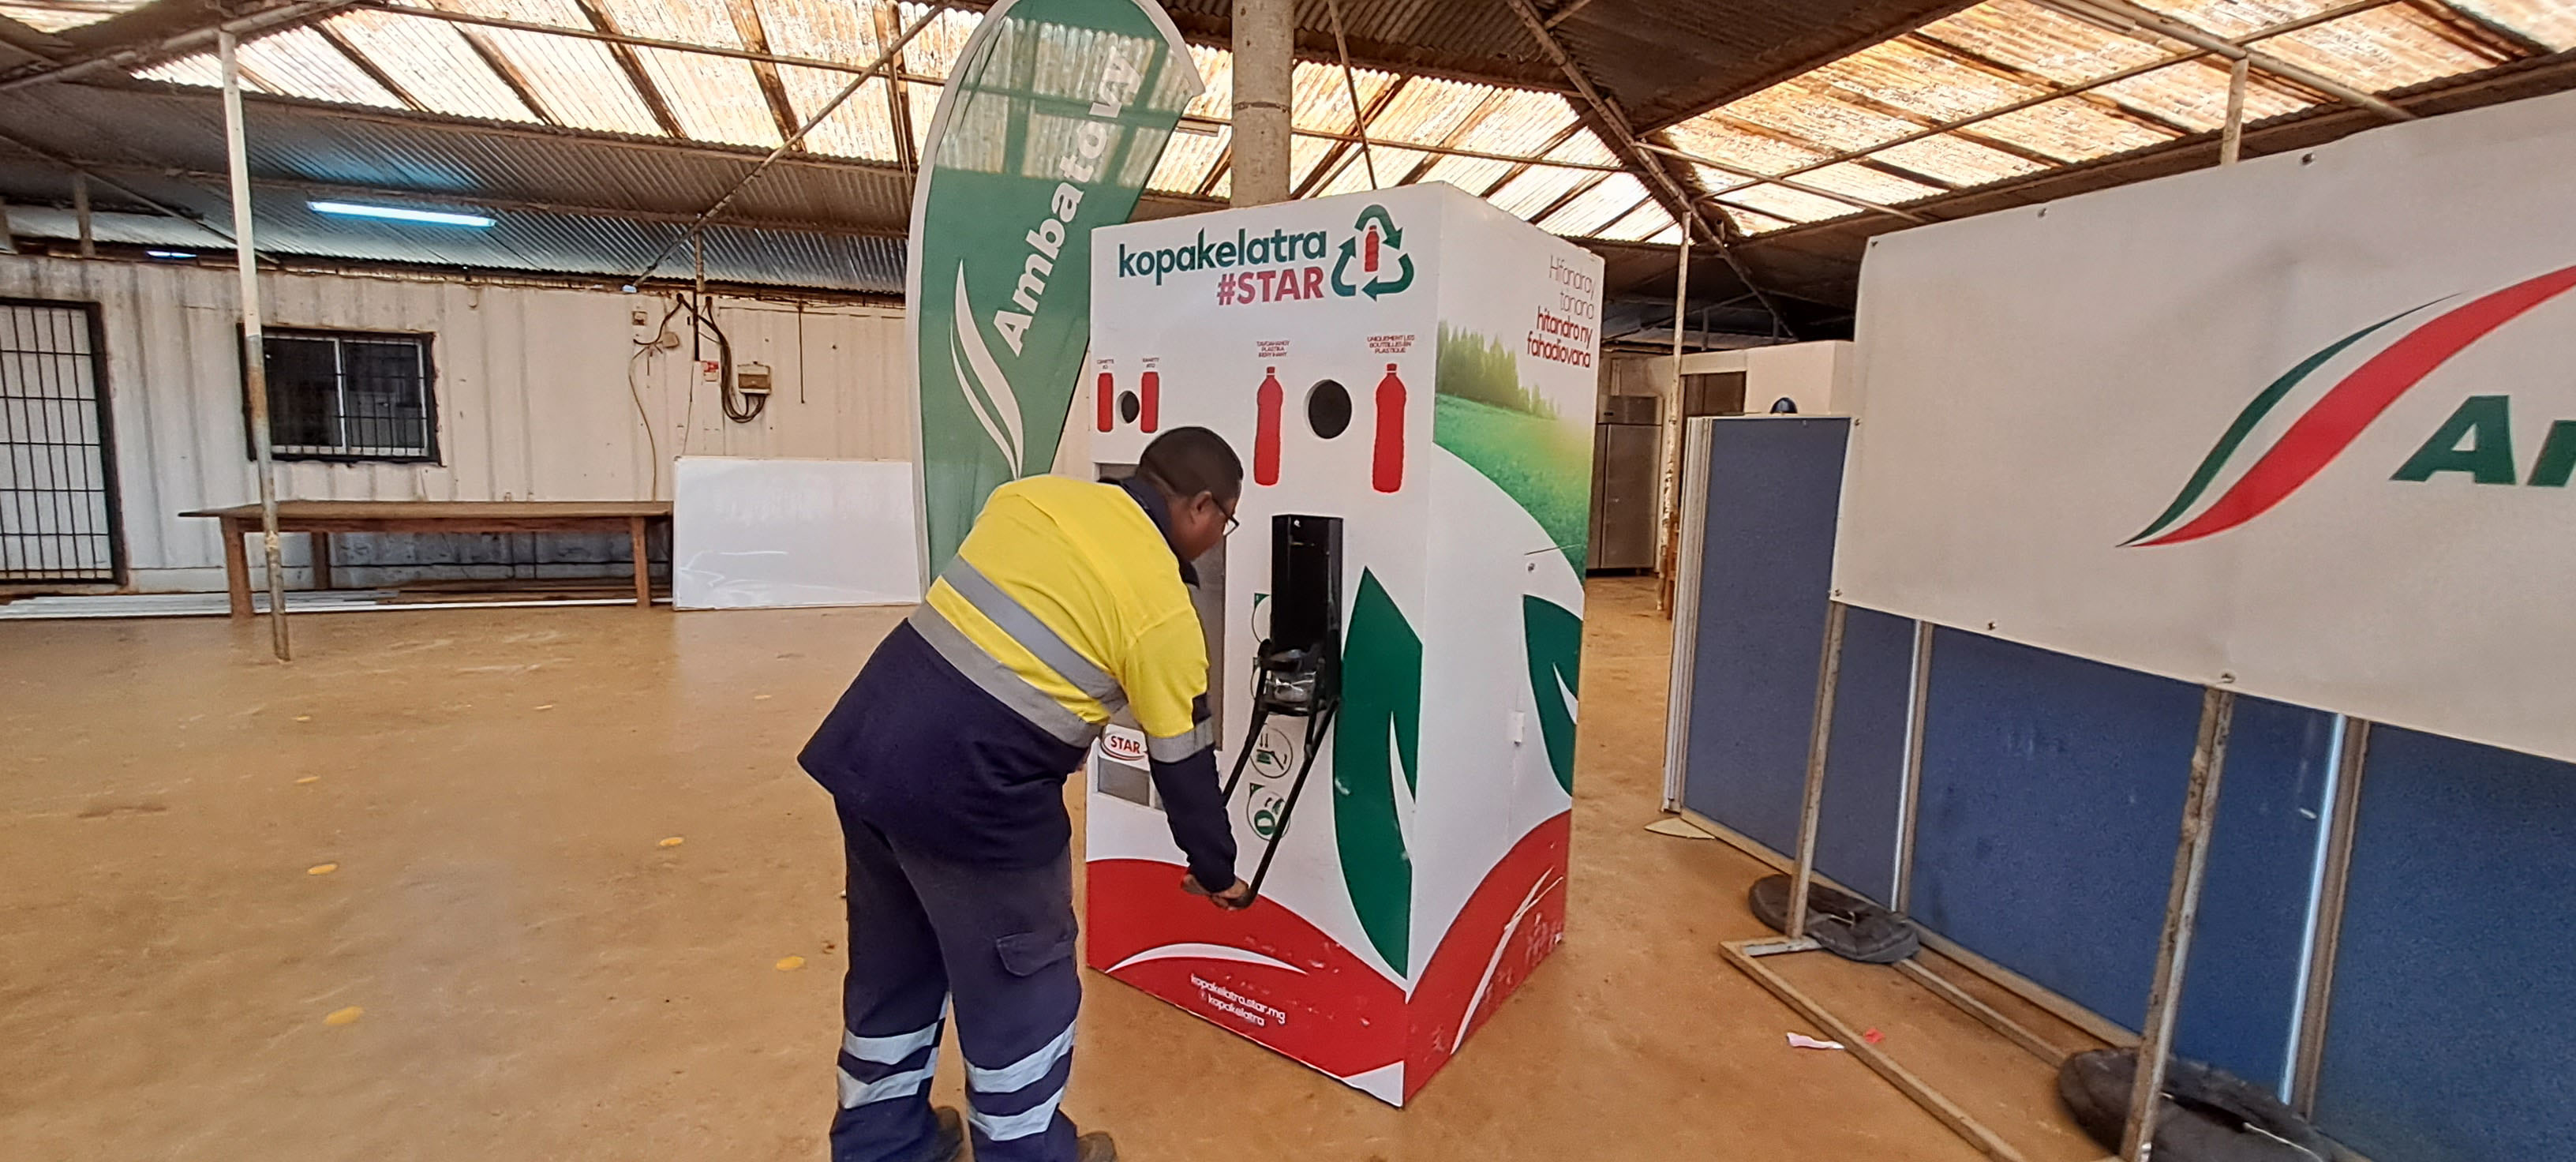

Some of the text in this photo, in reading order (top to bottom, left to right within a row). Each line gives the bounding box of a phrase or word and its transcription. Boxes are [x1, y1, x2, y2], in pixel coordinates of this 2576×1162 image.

[993, 46, 1143, 357] Ambatovy
[1119, 227, 1327, 286] kopakelatra
[1216, 267, 1324, 305] #STAR
[1527, 330, 1591, 368] fahadiovana
[1110, 735, 1140, 754] STAR
